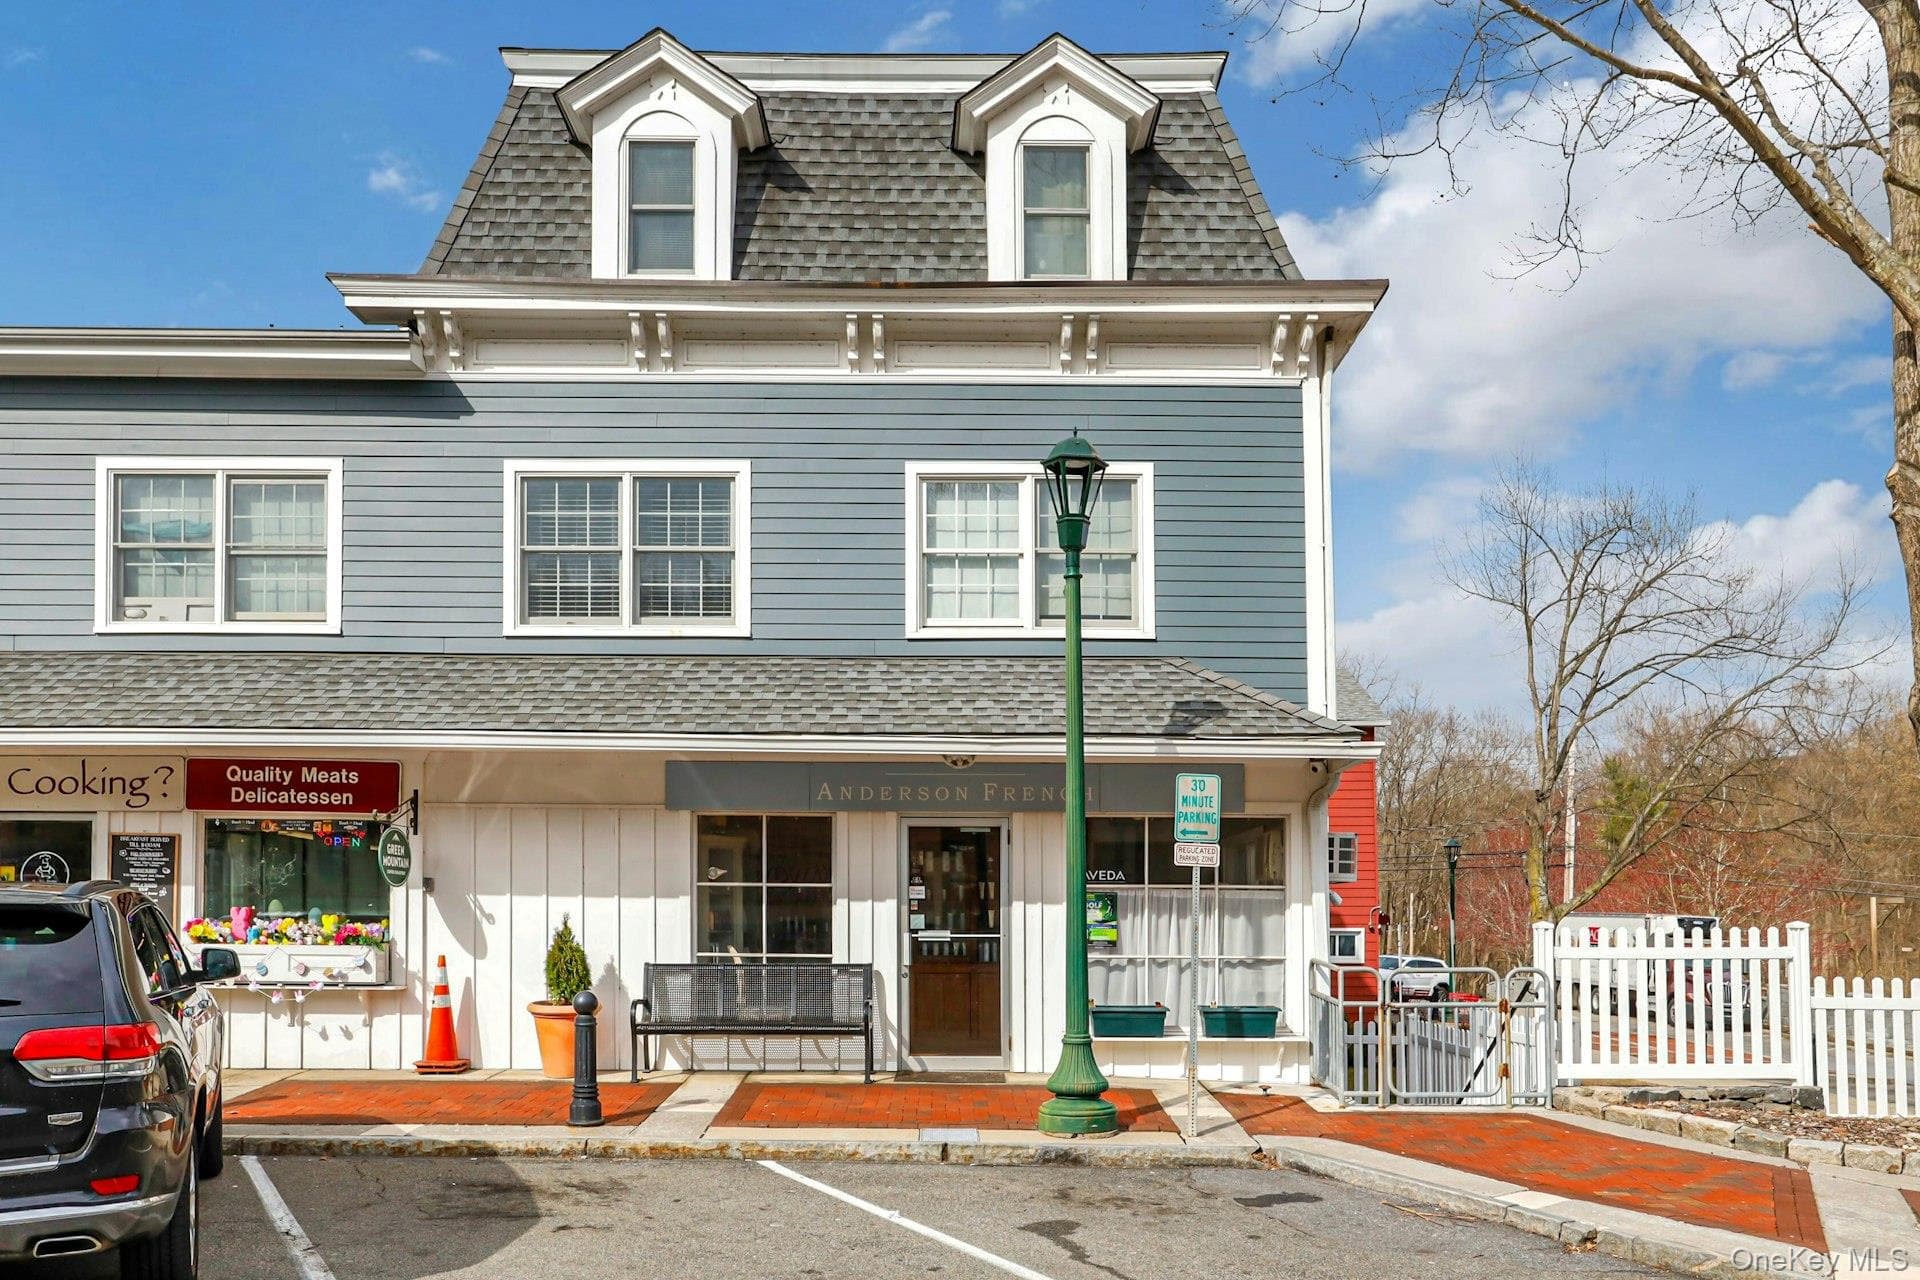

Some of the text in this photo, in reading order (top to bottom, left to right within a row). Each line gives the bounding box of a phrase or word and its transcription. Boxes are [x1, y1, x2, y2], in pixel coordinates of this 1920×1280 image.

[226, 765, 359, 785] Quality Meats
[7, 758, 175, 809] Cooking?
[1191, 779, 1206, 792] 30
[231, 787, 353, 805] Delicatessen
[817, 782, 968, 801] ANDERSON
[1181, 795, 1214, 808] MINUTE
[1178, 811, 1217, 825] PARKING
[323, 836, 361, 848] OPEN
[386, 843, 405, 856] GREEN
[382, 855, 409, 869] MOUNTAIN
[1179, 854, 1200, 863] PARKING
